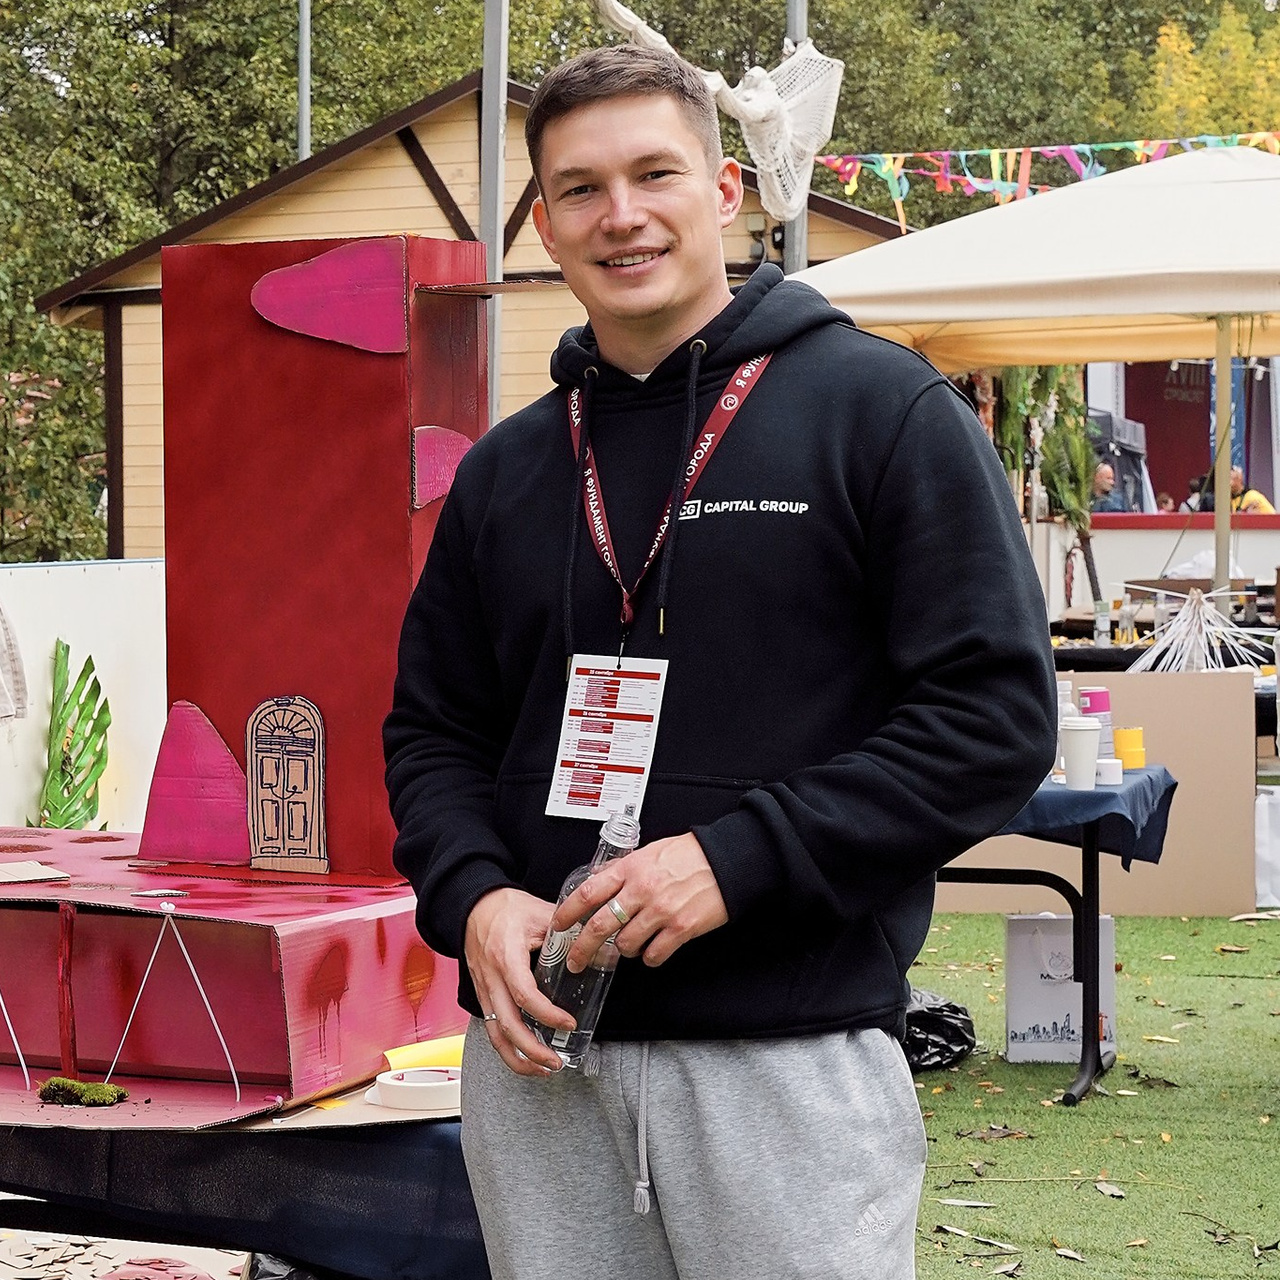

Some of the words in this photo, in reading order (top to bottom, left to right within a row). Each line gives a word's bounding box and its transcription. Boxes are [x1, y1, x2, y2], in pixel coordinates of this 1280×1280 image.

[570, 387, 581, 427] ОРОДА
[586, 477, 606, 545] ФУНДАМЕНТ
[704, 500, 757, 513] CAPITAL
[759, 500, 809, 514] GROUP
